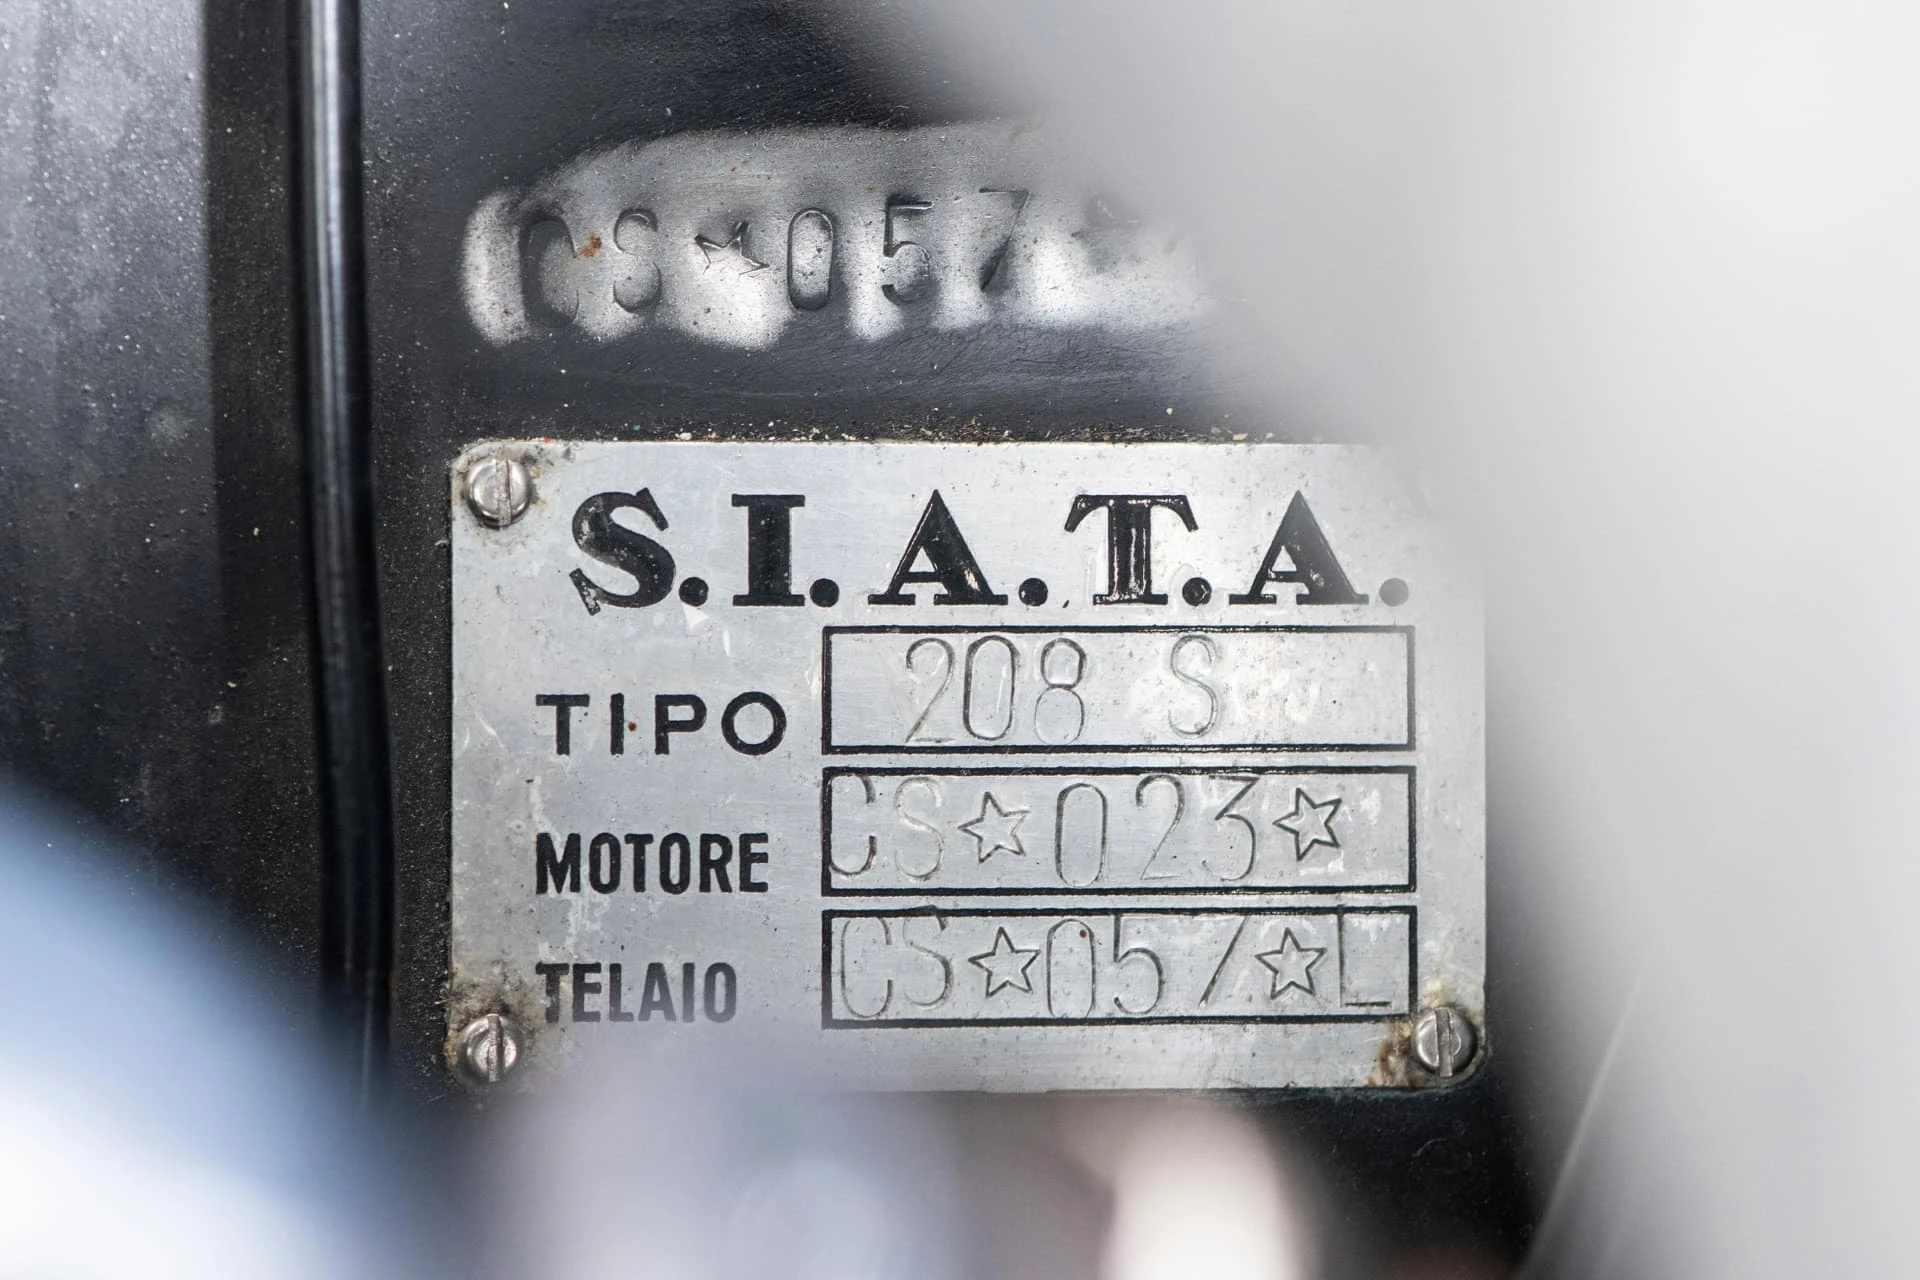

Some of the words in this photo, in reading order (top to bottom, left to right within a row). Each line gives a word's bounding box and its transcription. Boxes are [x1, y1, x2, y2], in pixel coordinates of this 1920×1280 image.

[568, 487, 1410, 616] S.I.A.T.A.
[535, 691, 787, 756] TIPO
[906, 635, 1087, 745] 208
[535, 832, 768, 895] MOTORE
[535, 962, 737, 1023] TELAIO
